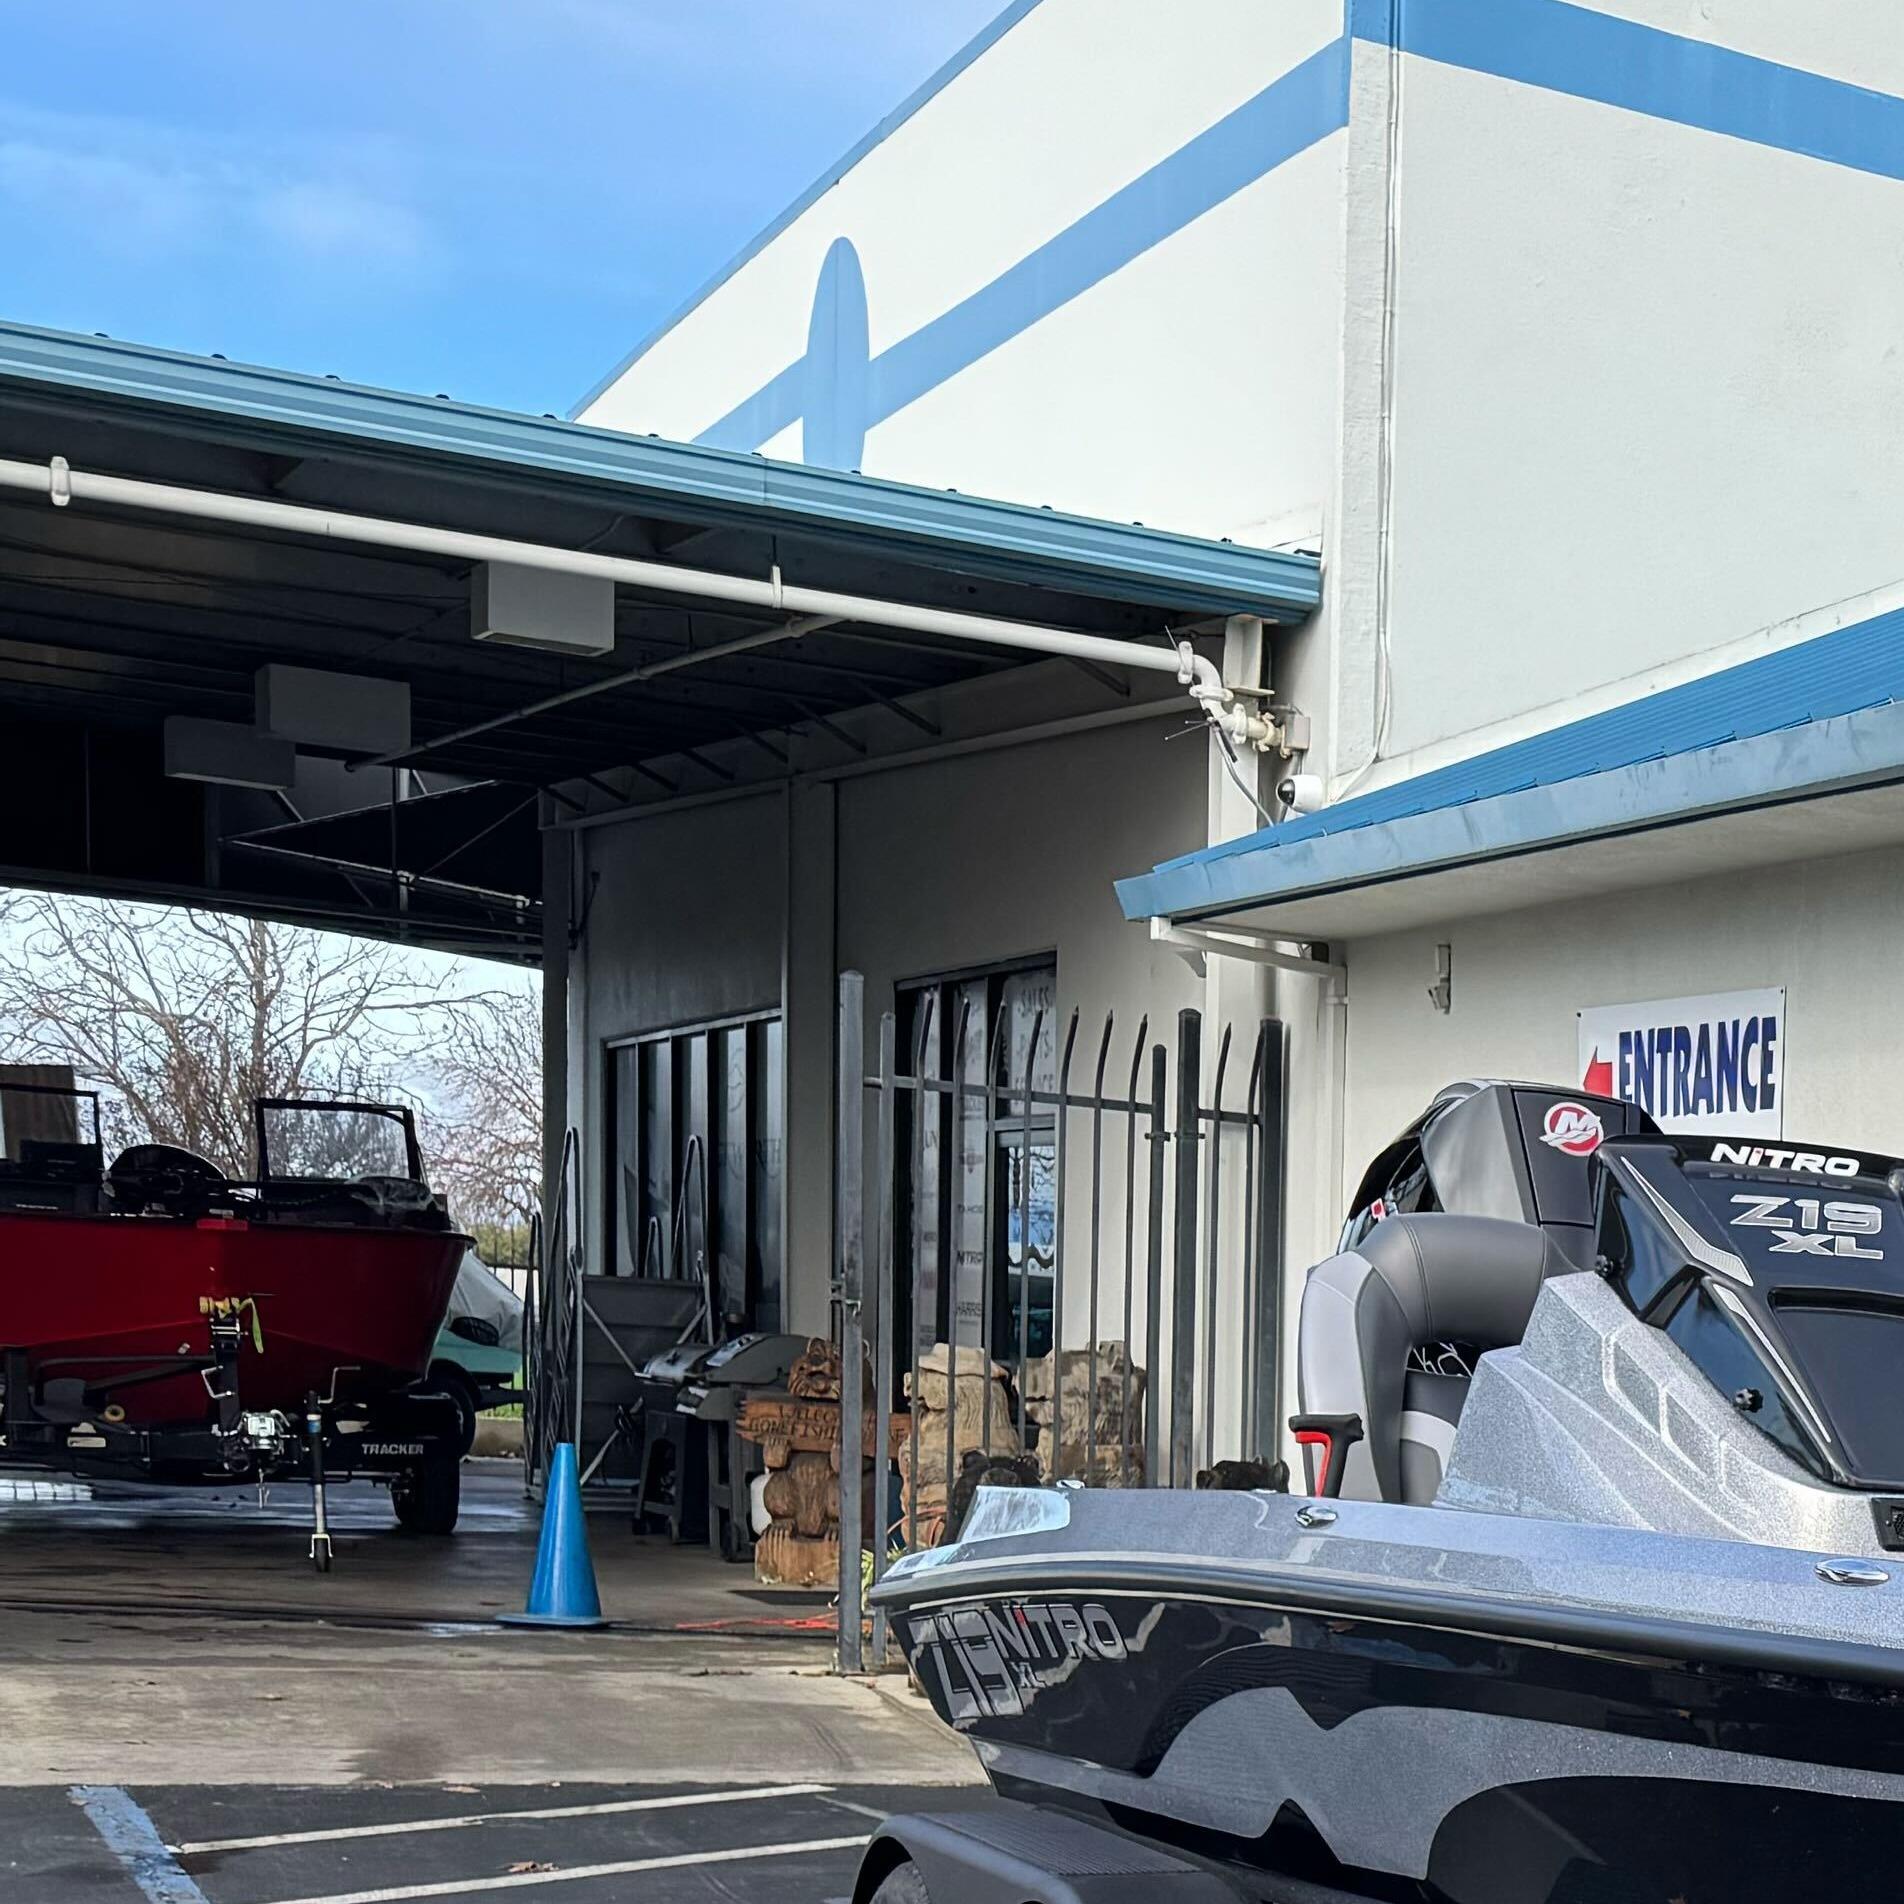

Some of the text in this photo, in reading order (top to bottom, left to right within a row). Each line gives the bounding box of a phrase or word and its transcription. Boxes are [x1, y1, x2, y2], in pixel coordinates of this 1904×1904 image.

[1619, 1016, 1777, 1117] ENTRANCE
[1709, 1142, 1860, 1177] NITRO
[1730, 1194, 1882, 1234] Z19
[1768, 1230, 1884, 1260] XL
[361, 1443, 424, 1455] TRACKER
[985, 1603, 1128, 1660] NITRO
[1011, 1661, 1047, 1688] XL
